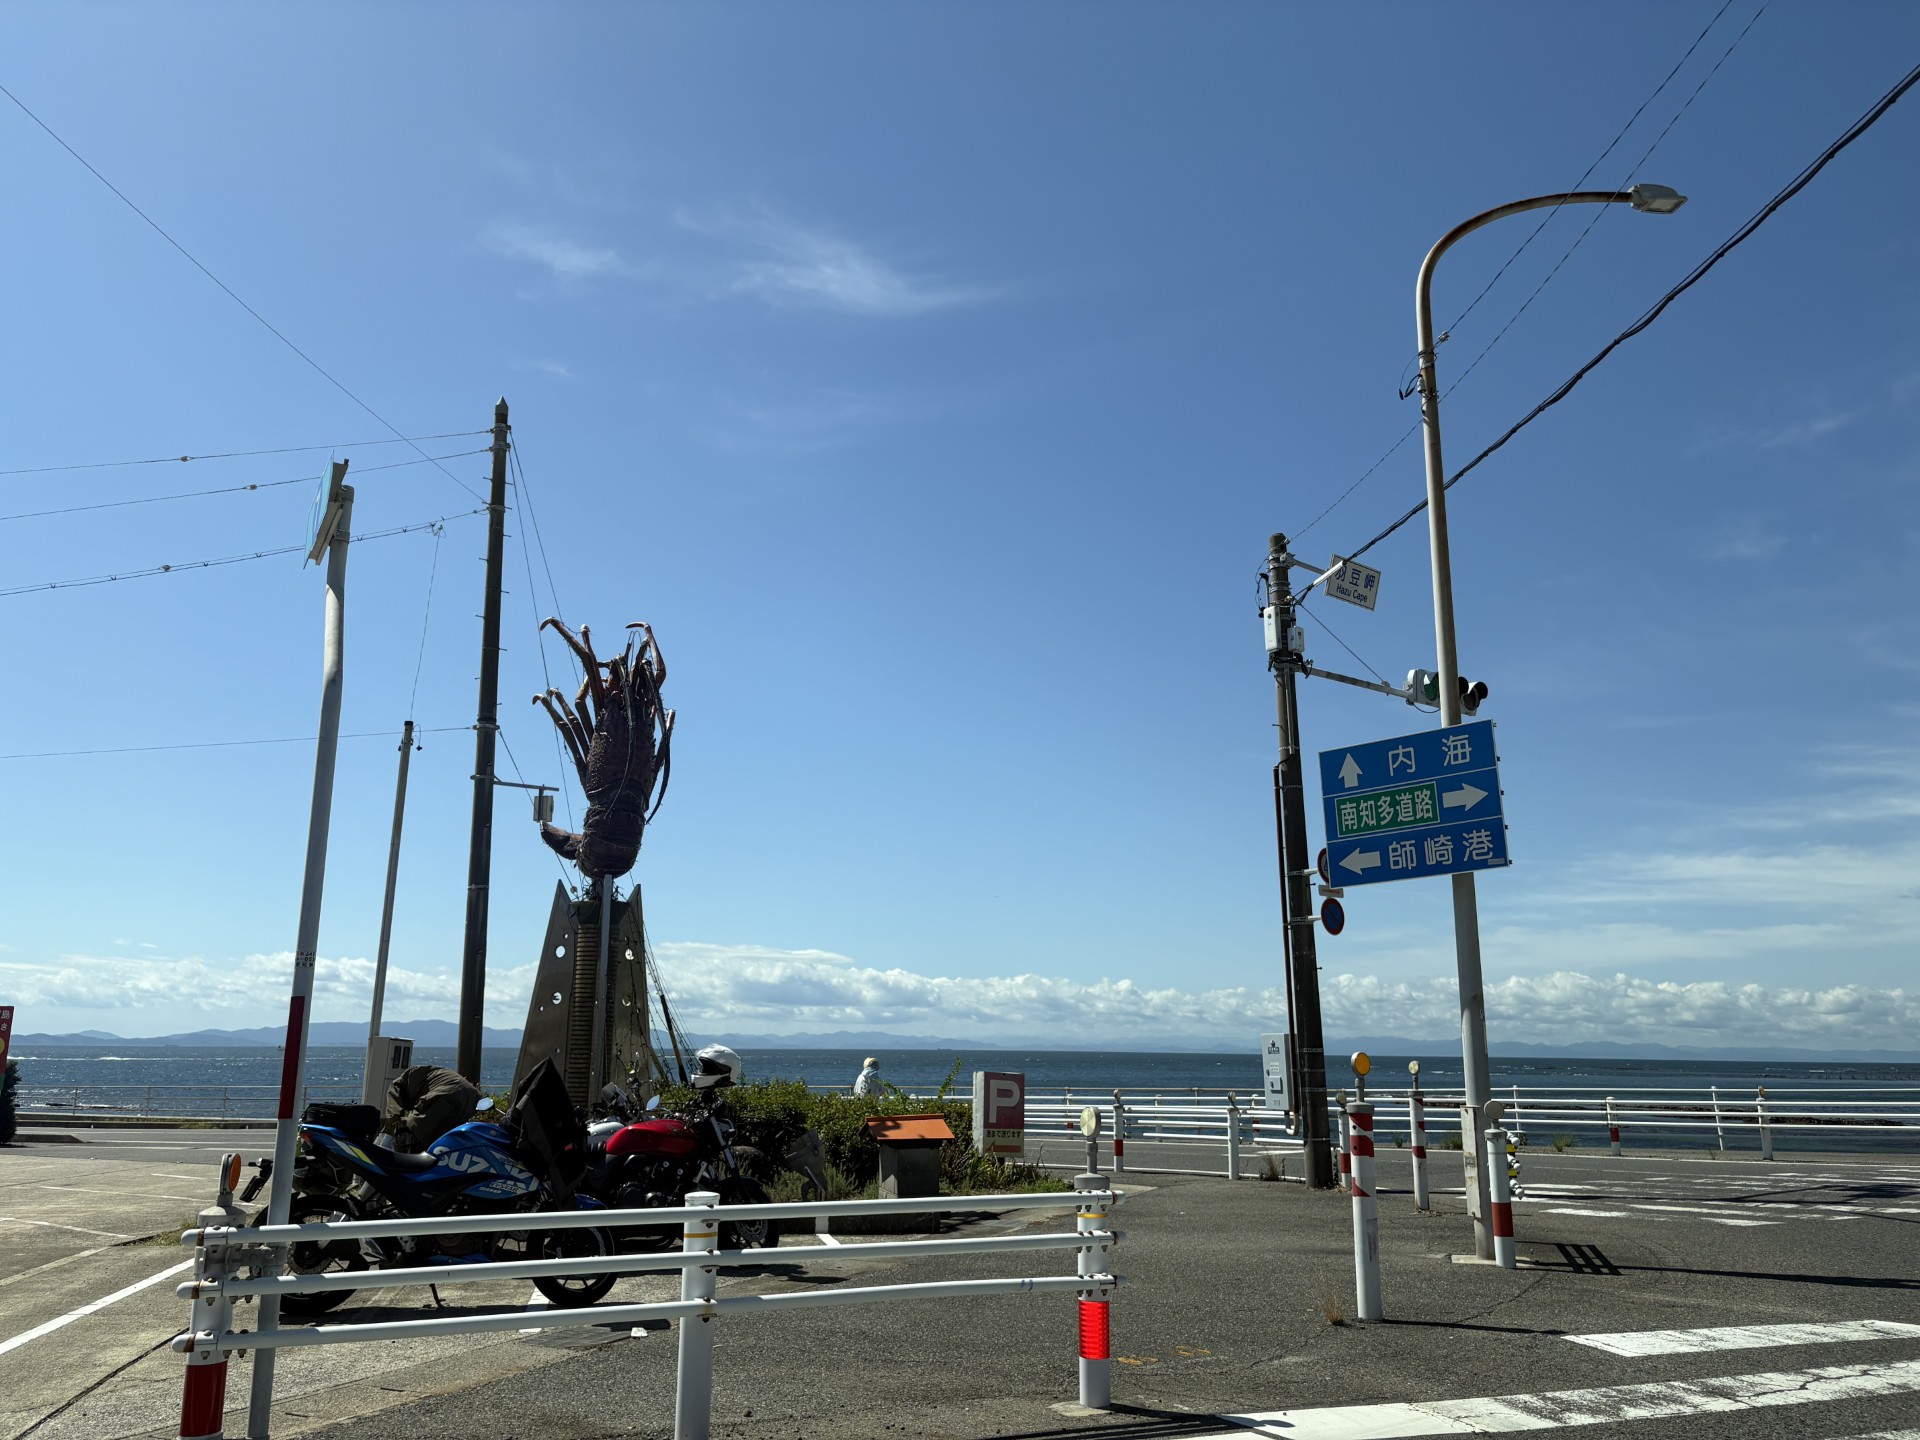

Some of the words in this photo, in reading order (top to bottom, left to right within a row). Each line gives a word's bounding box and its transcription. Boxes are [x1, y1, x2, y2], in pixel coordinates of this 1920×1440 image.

[1336, 583, 1352, 597] Hazu
[1352, 590, 1368, 603] Cape
[1388, 734, 1472, 777] 内海
[1340, 789, 1433, 832] 南知多道路
[1388, 829, 1493, 871] 師崎港
[989, 1079, 1020, 1123] P
